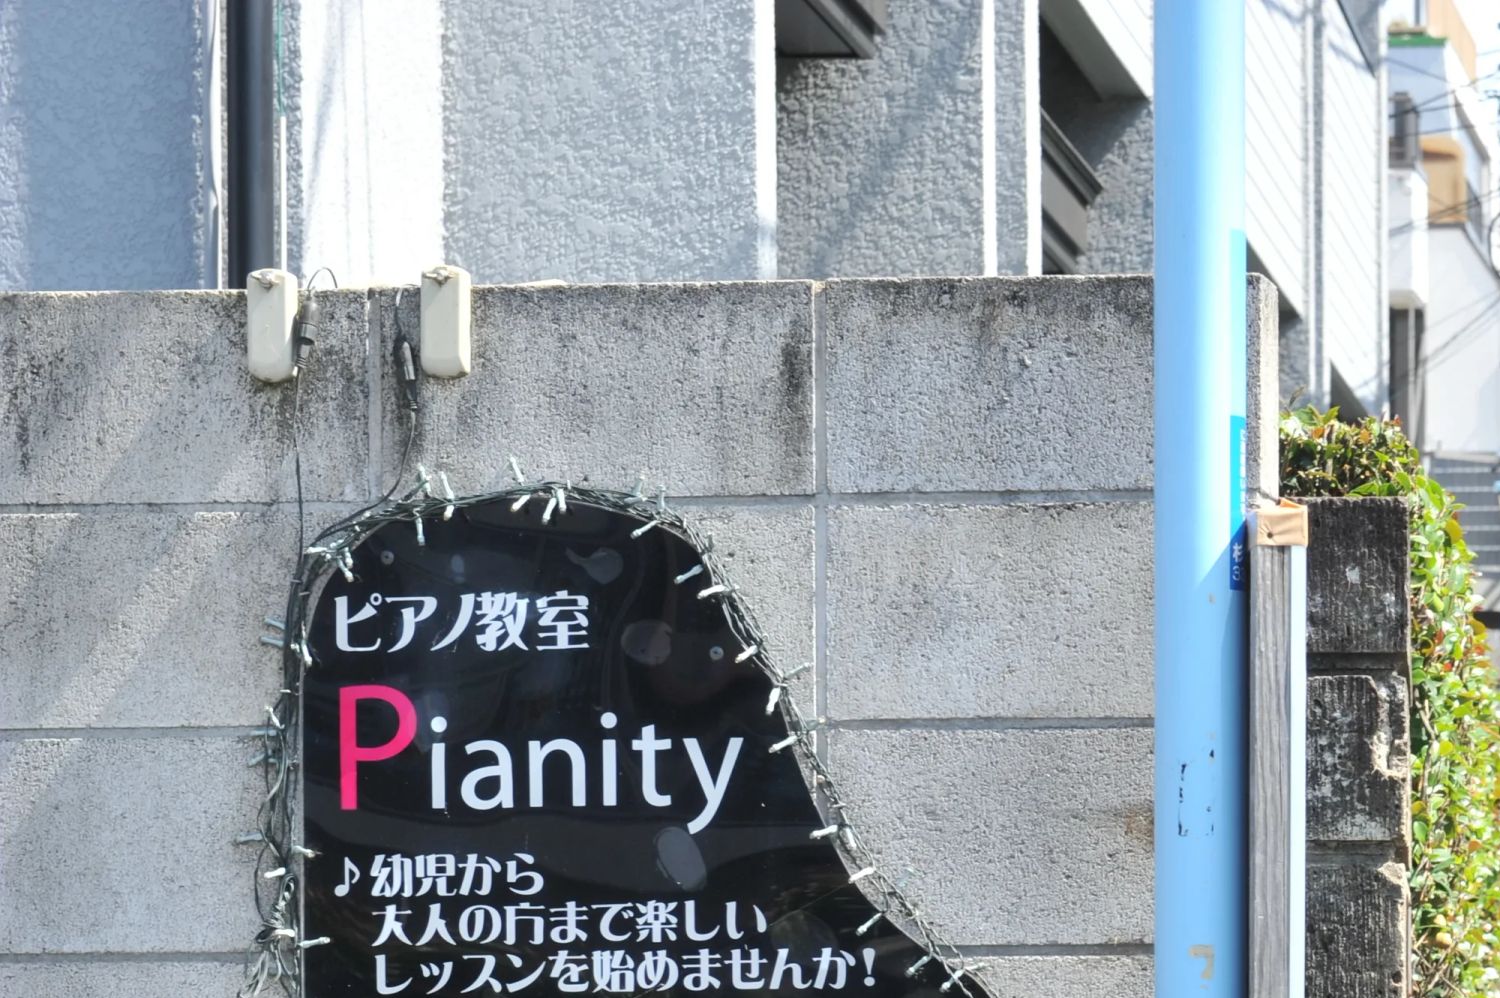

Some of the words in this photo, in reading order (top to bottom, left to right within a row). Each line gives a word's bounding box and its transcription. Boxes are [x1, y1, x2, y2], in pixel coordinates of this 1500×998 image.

[334, 590, 590, 653] ピアノ教室
[339, 685, 744, 834] Pianity
[370, 853, 544, 897] 幼児から
[371, 901, 768, 946] 大人の方まで楽しい
